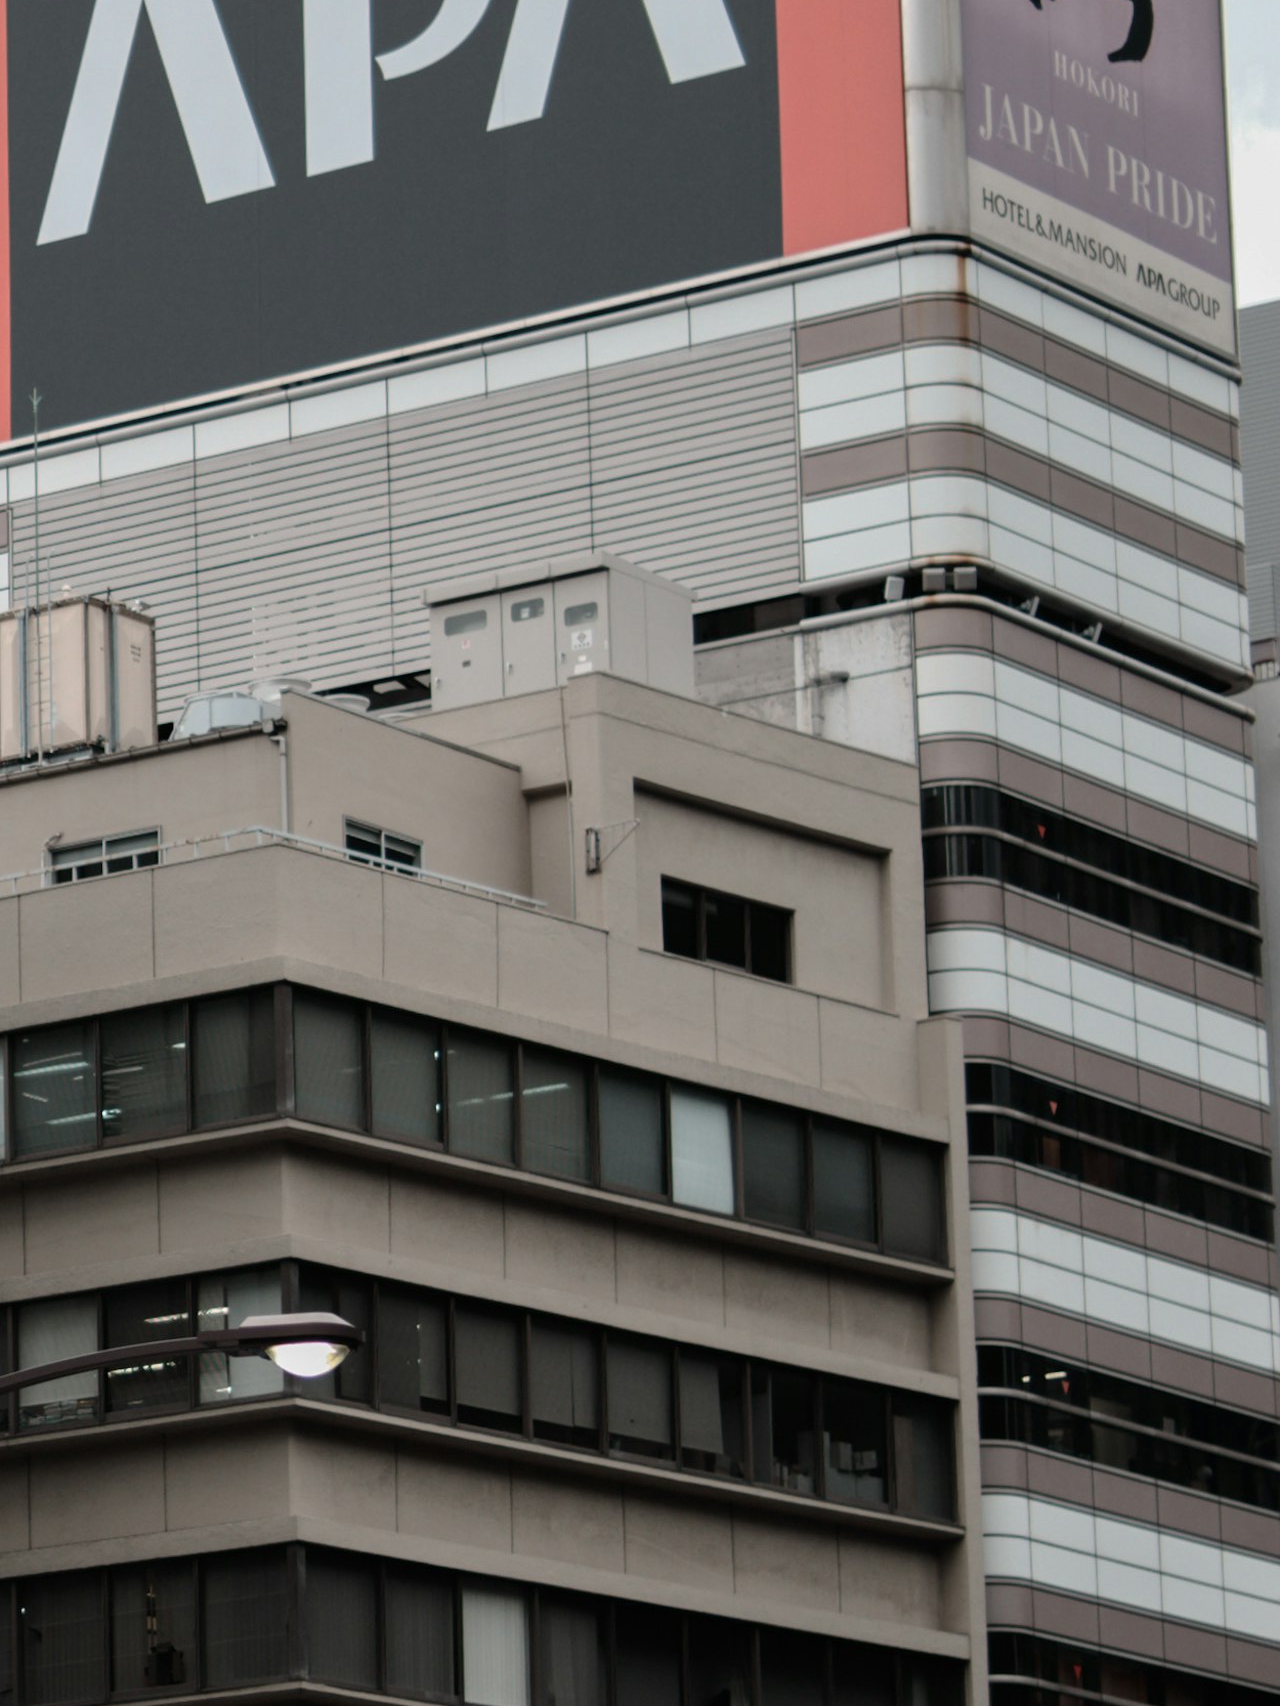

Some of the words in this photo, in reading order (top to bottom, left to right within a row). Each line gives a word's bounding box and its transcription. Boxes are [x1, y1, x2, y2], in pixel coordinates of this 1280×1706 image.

[1053, 50, 1139, 117] HOKORI
[979, 83, 1090, 179] JAPAN
[1106, 144, 1218, 243] PRIDE
